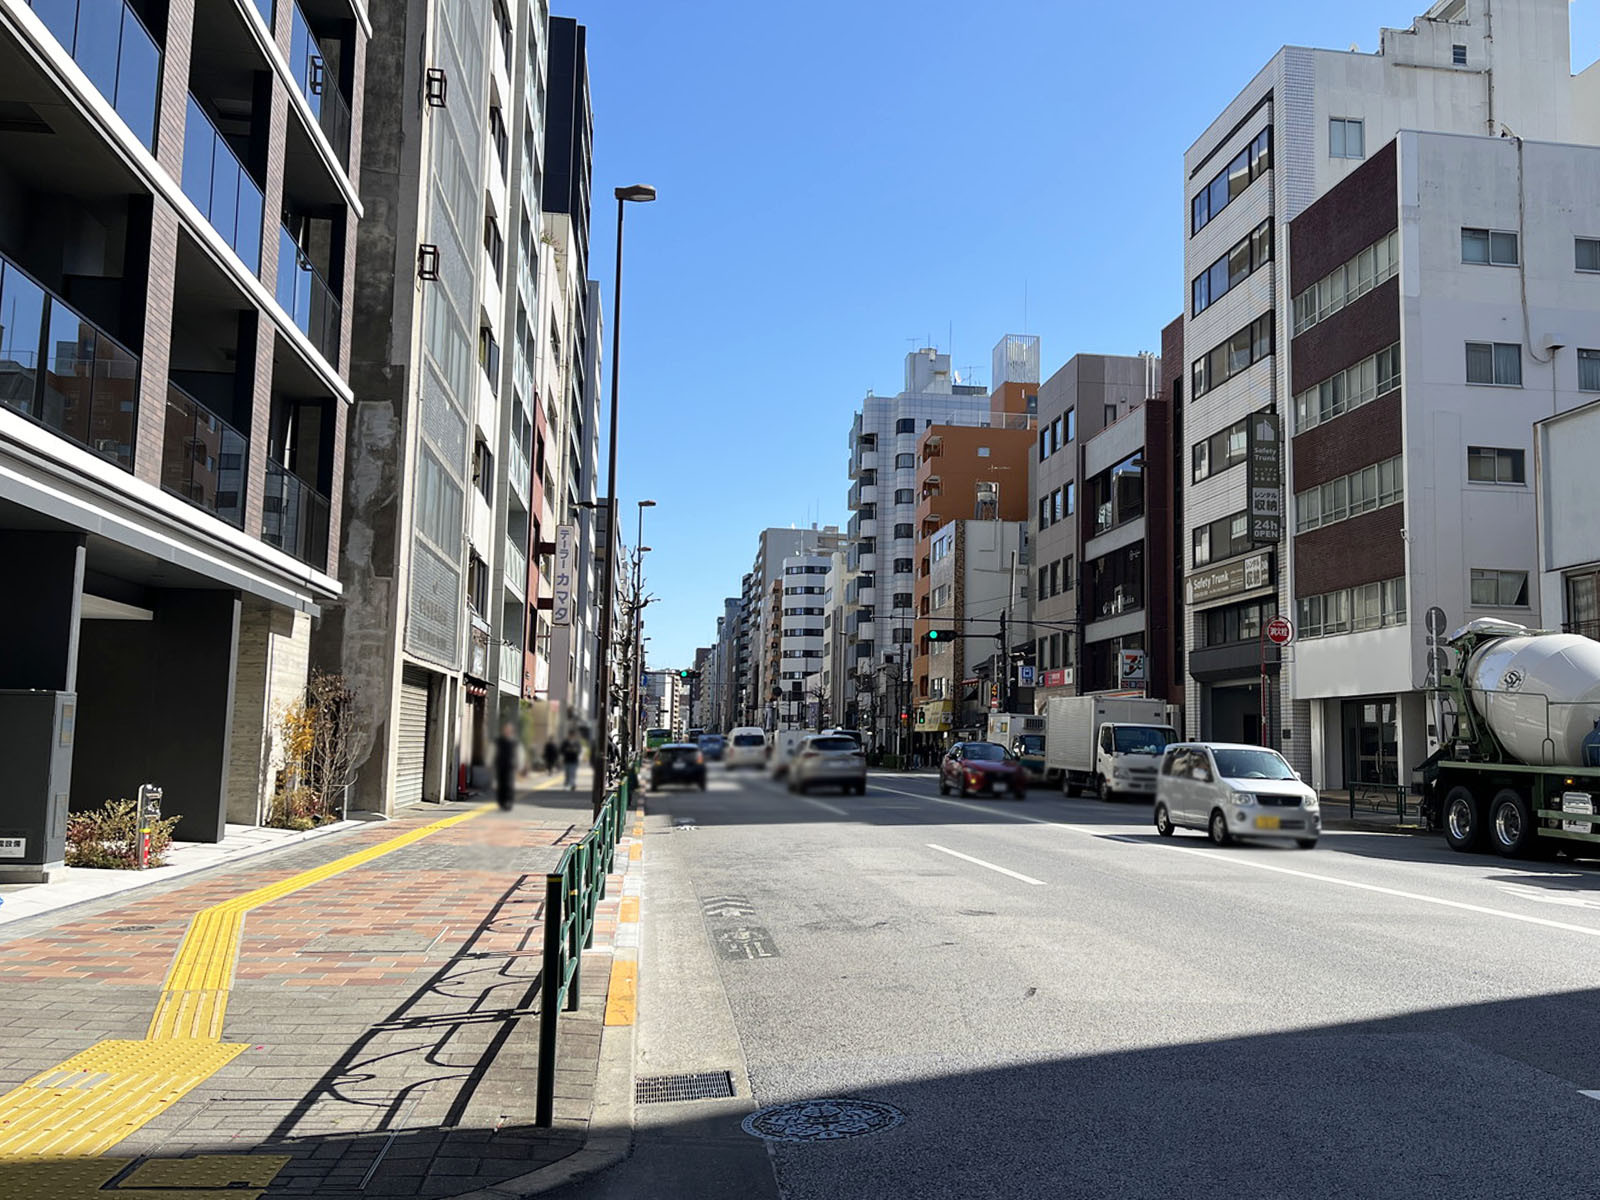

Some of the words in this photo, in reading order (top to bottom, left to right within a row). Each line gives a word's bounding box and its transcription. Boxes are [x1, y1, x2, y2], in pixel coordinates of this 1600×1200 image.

[1254, 447, 1278, 455] Safety
[1254, 491, 1278, 499] レンタル
[1254, 499, 1278, 512] 収納
[1254, 519, 1278, 530] 24h
[1254, 530, 1279, 538] OPEN
[1193, 576, 1211, 590] Safety
[1211, 570, 1229, 585] Trunk
[1270, 626, 1288, 637] 消火栓
